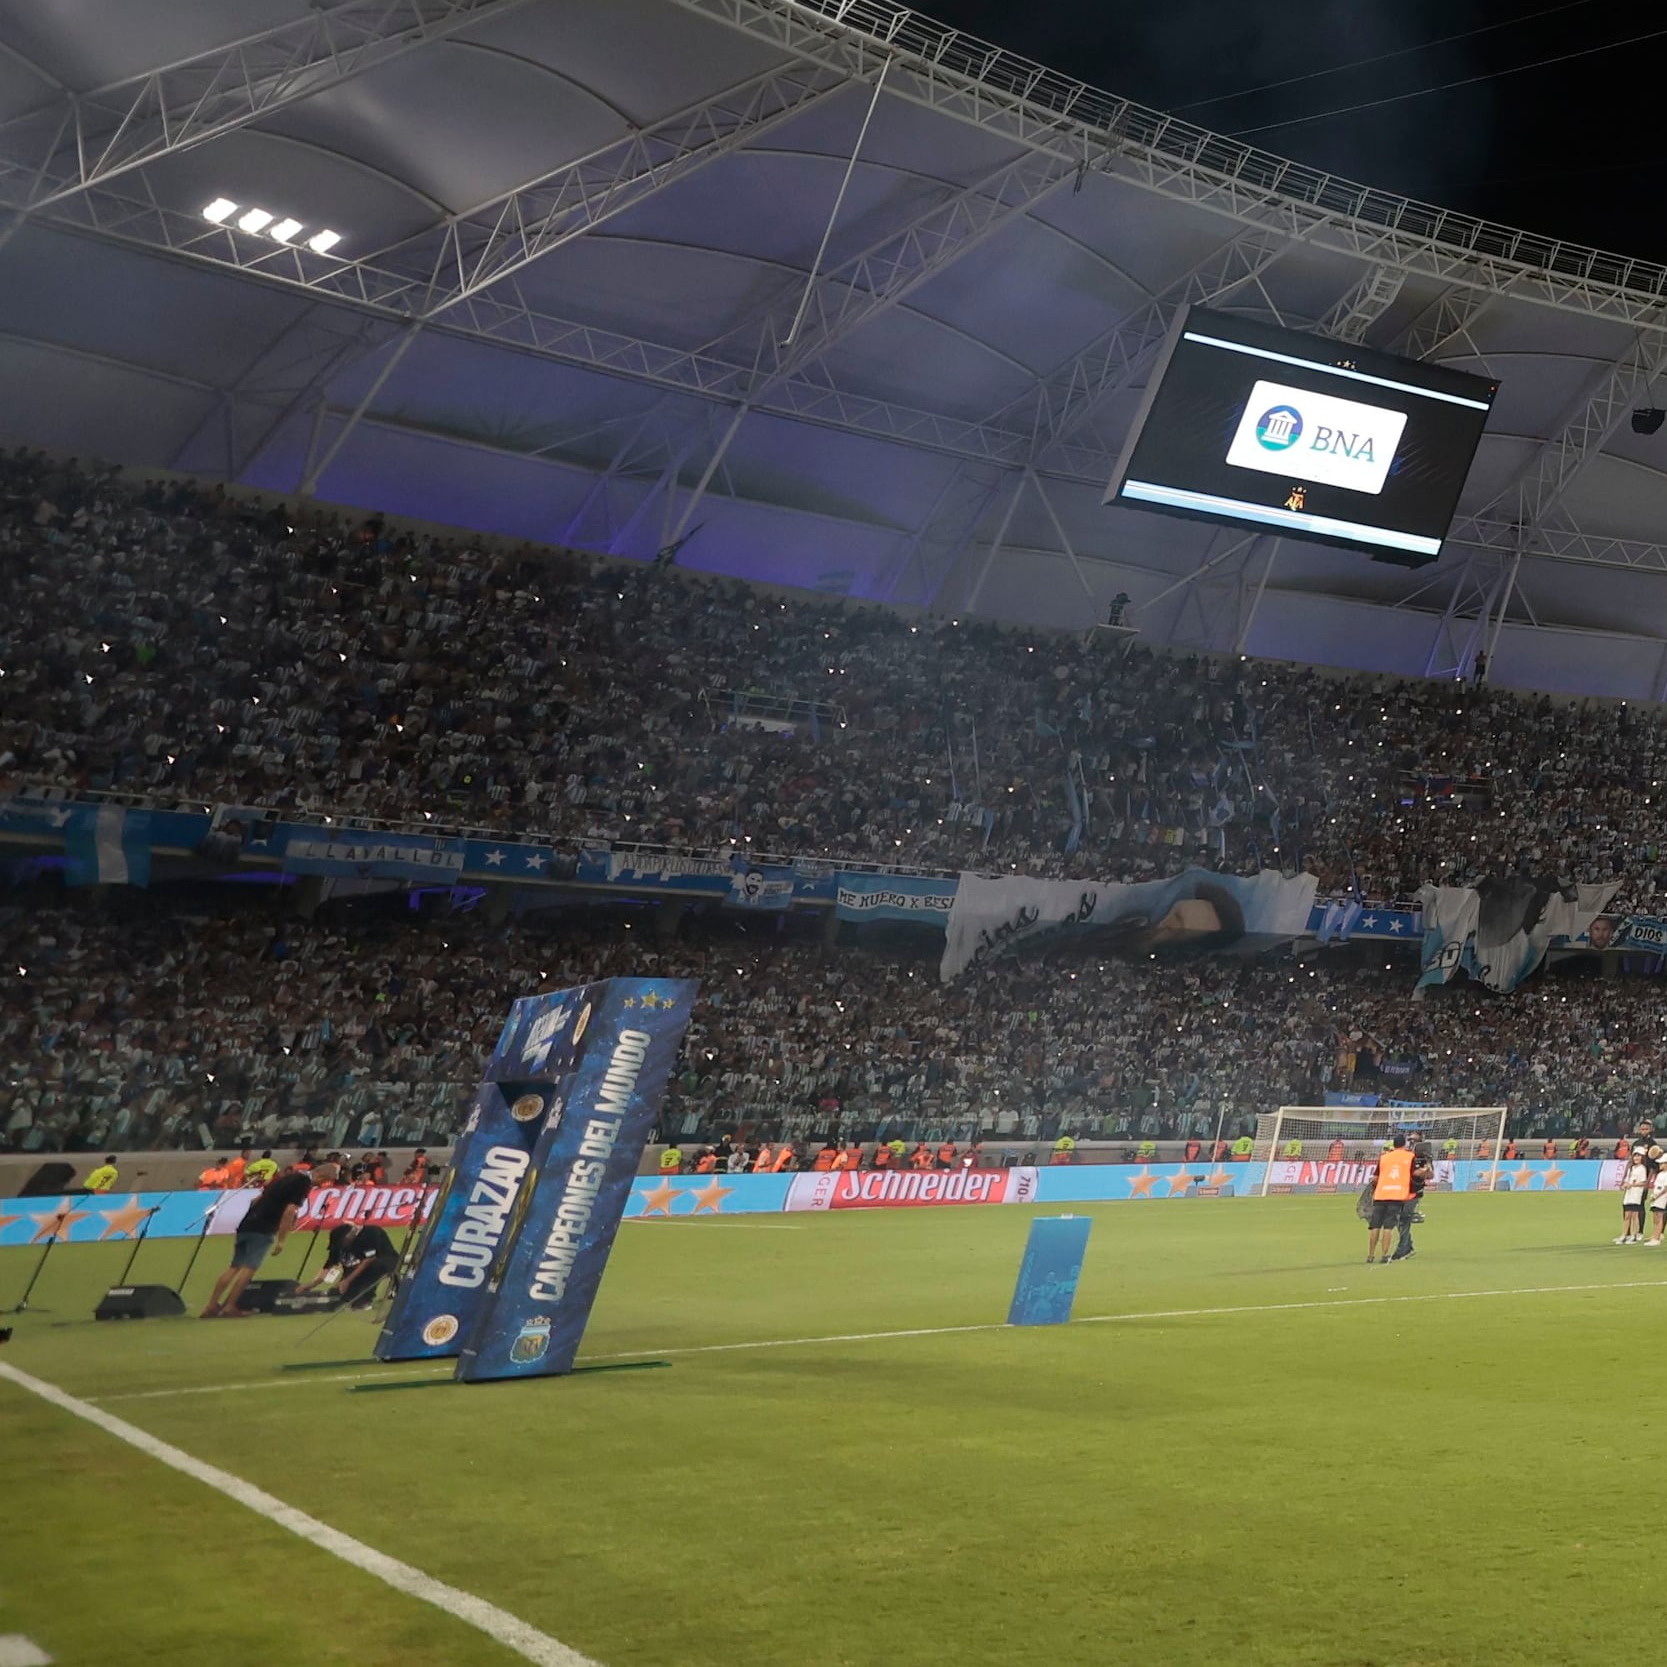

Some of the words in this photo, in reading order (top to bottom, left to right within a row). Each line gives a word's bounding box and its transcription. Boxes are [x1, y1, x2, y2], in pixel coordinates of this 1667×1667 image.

[1309, 425, 1376, 463] BNA
[1633, 926, 1663, 944] DIOS
[595, 1029, 651, 1115] MUNDO
[579, 1117, 622, 1160] DEL
[841, 1167, 1000, 1201] Schneider
[439, 1146, 530, 1288] CURAZAO
[529, 1159, 606, 1301] CAMPEONES
